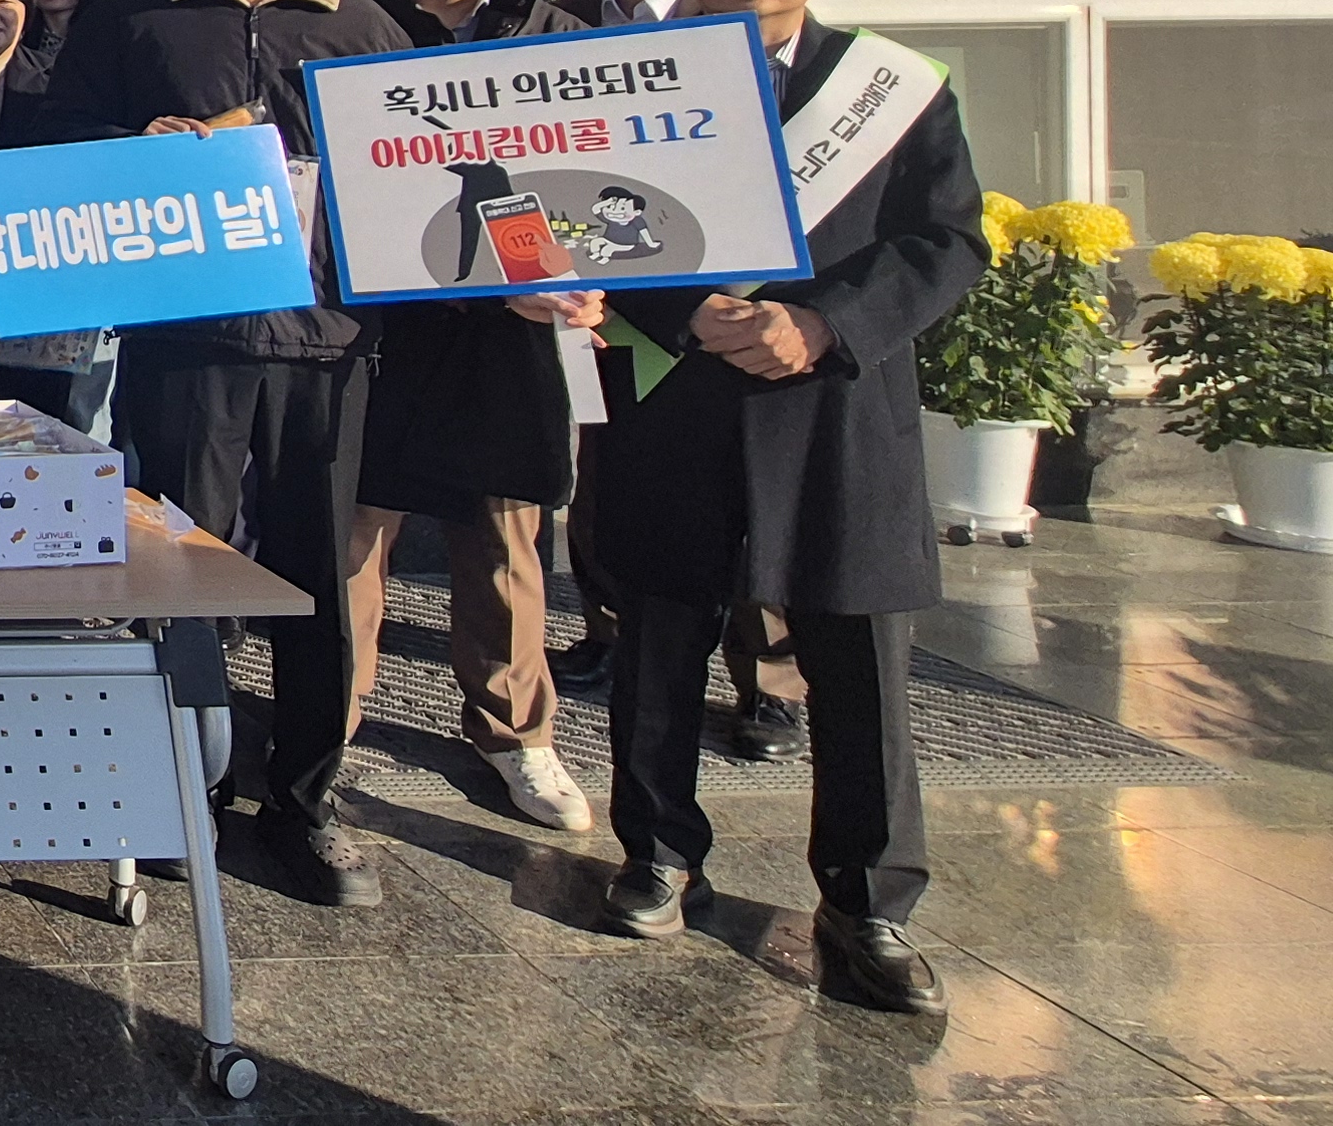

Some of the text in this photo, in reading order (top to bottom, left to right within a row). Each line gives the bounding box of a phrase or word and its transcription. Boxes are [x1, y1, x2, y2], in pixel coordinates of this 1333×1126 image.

[383, 57, 682, 116] 혹시나 의심되면
[370, 108, 718, 168] 아이지킴이콜 112
[790, 66, 900, 195] 아동학대 신고
[213, 184, 284, 251] 날!
[510, 232, 537, 249] 112
